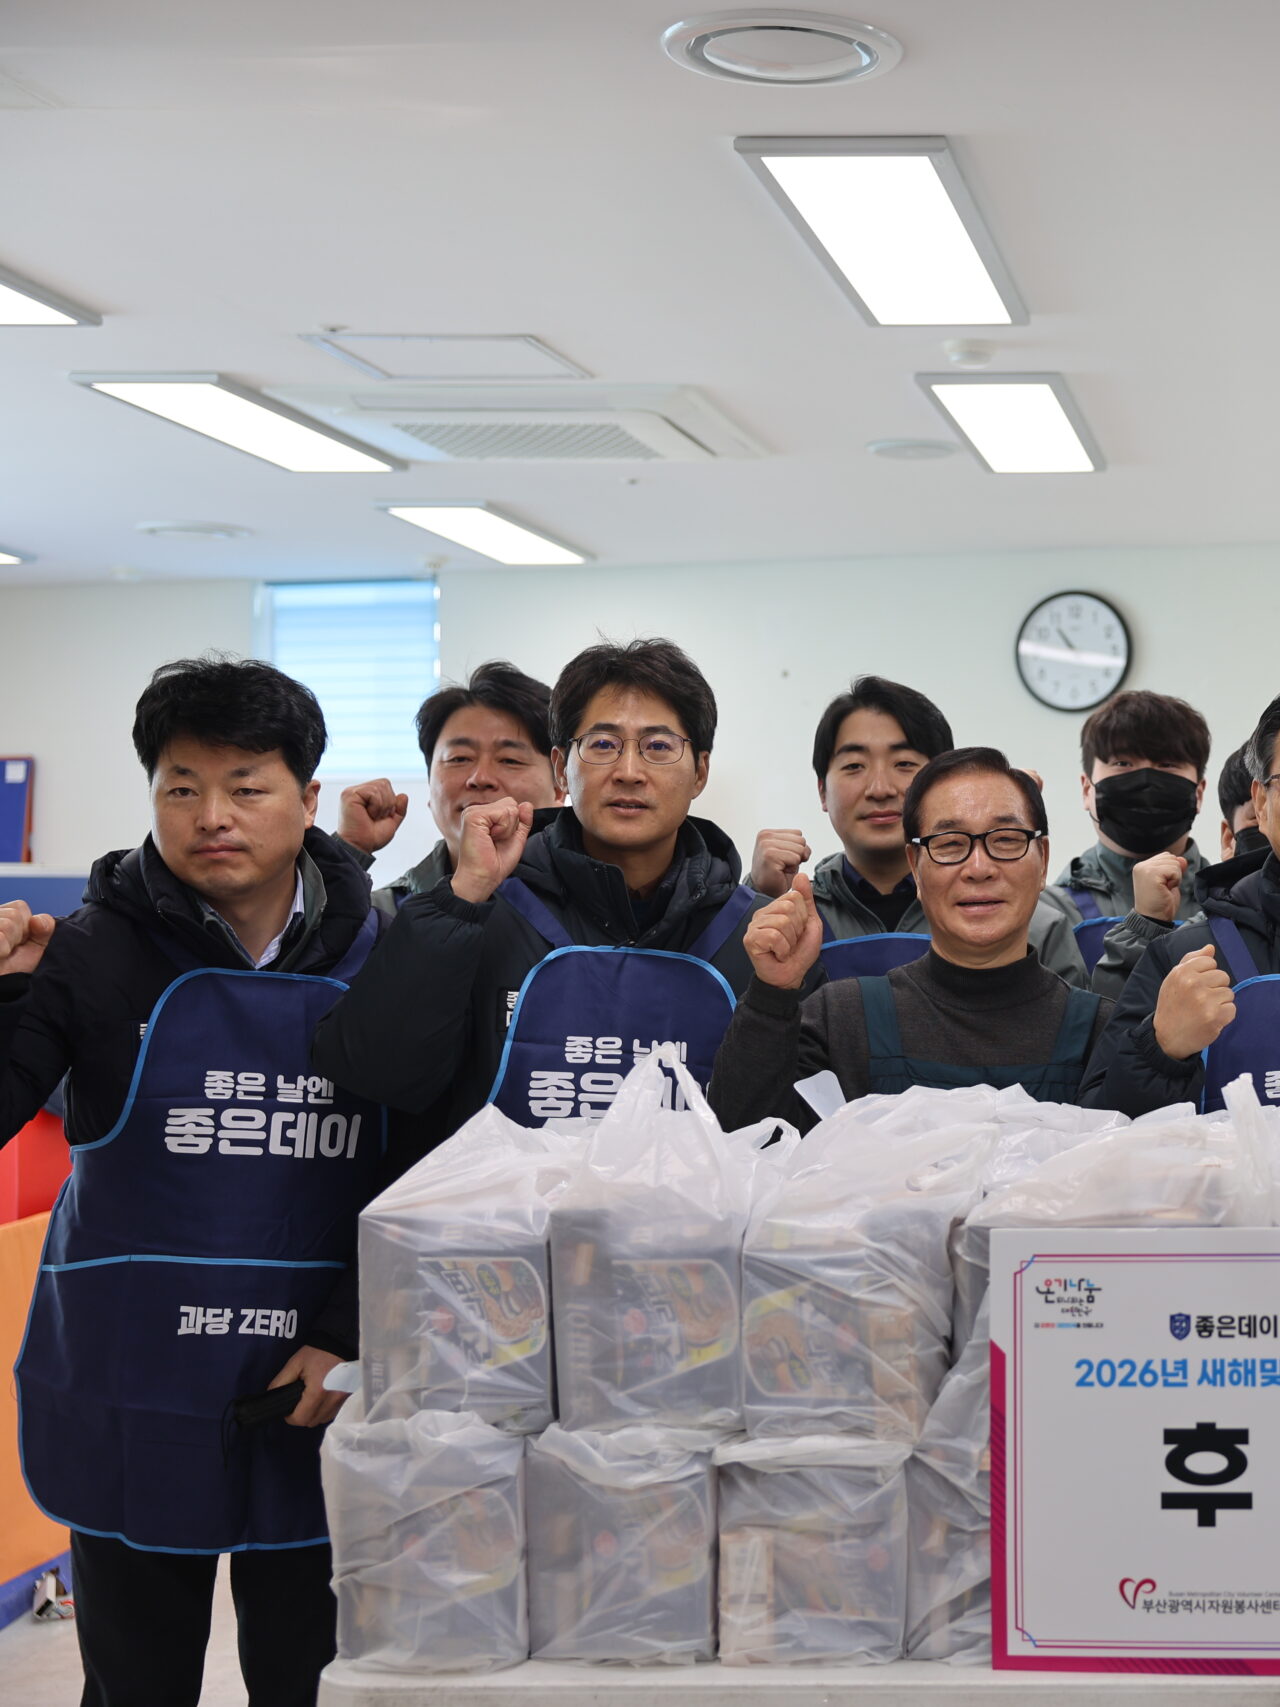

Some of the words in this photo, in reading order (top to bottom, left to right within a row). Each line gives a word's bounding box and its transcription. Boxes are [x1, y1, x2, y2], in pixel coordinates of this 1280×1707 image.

[565, 1035, 623, 1064] 좋은
[204, 1070, 266, 1100] 좋은
[276, 1074, 334, 1104] 날엔
[164, 1107, 362, 1159] 좋은데이
[1036, 1278, 1102, 1304] 온기나눔
[177, 1305, 234, 1336] 과당
[238, 1308, 298, 1339] ZERO
[1074, 1357, 1189, 1388] 2026년
[1160, 1422, 1253, 1527] 후
